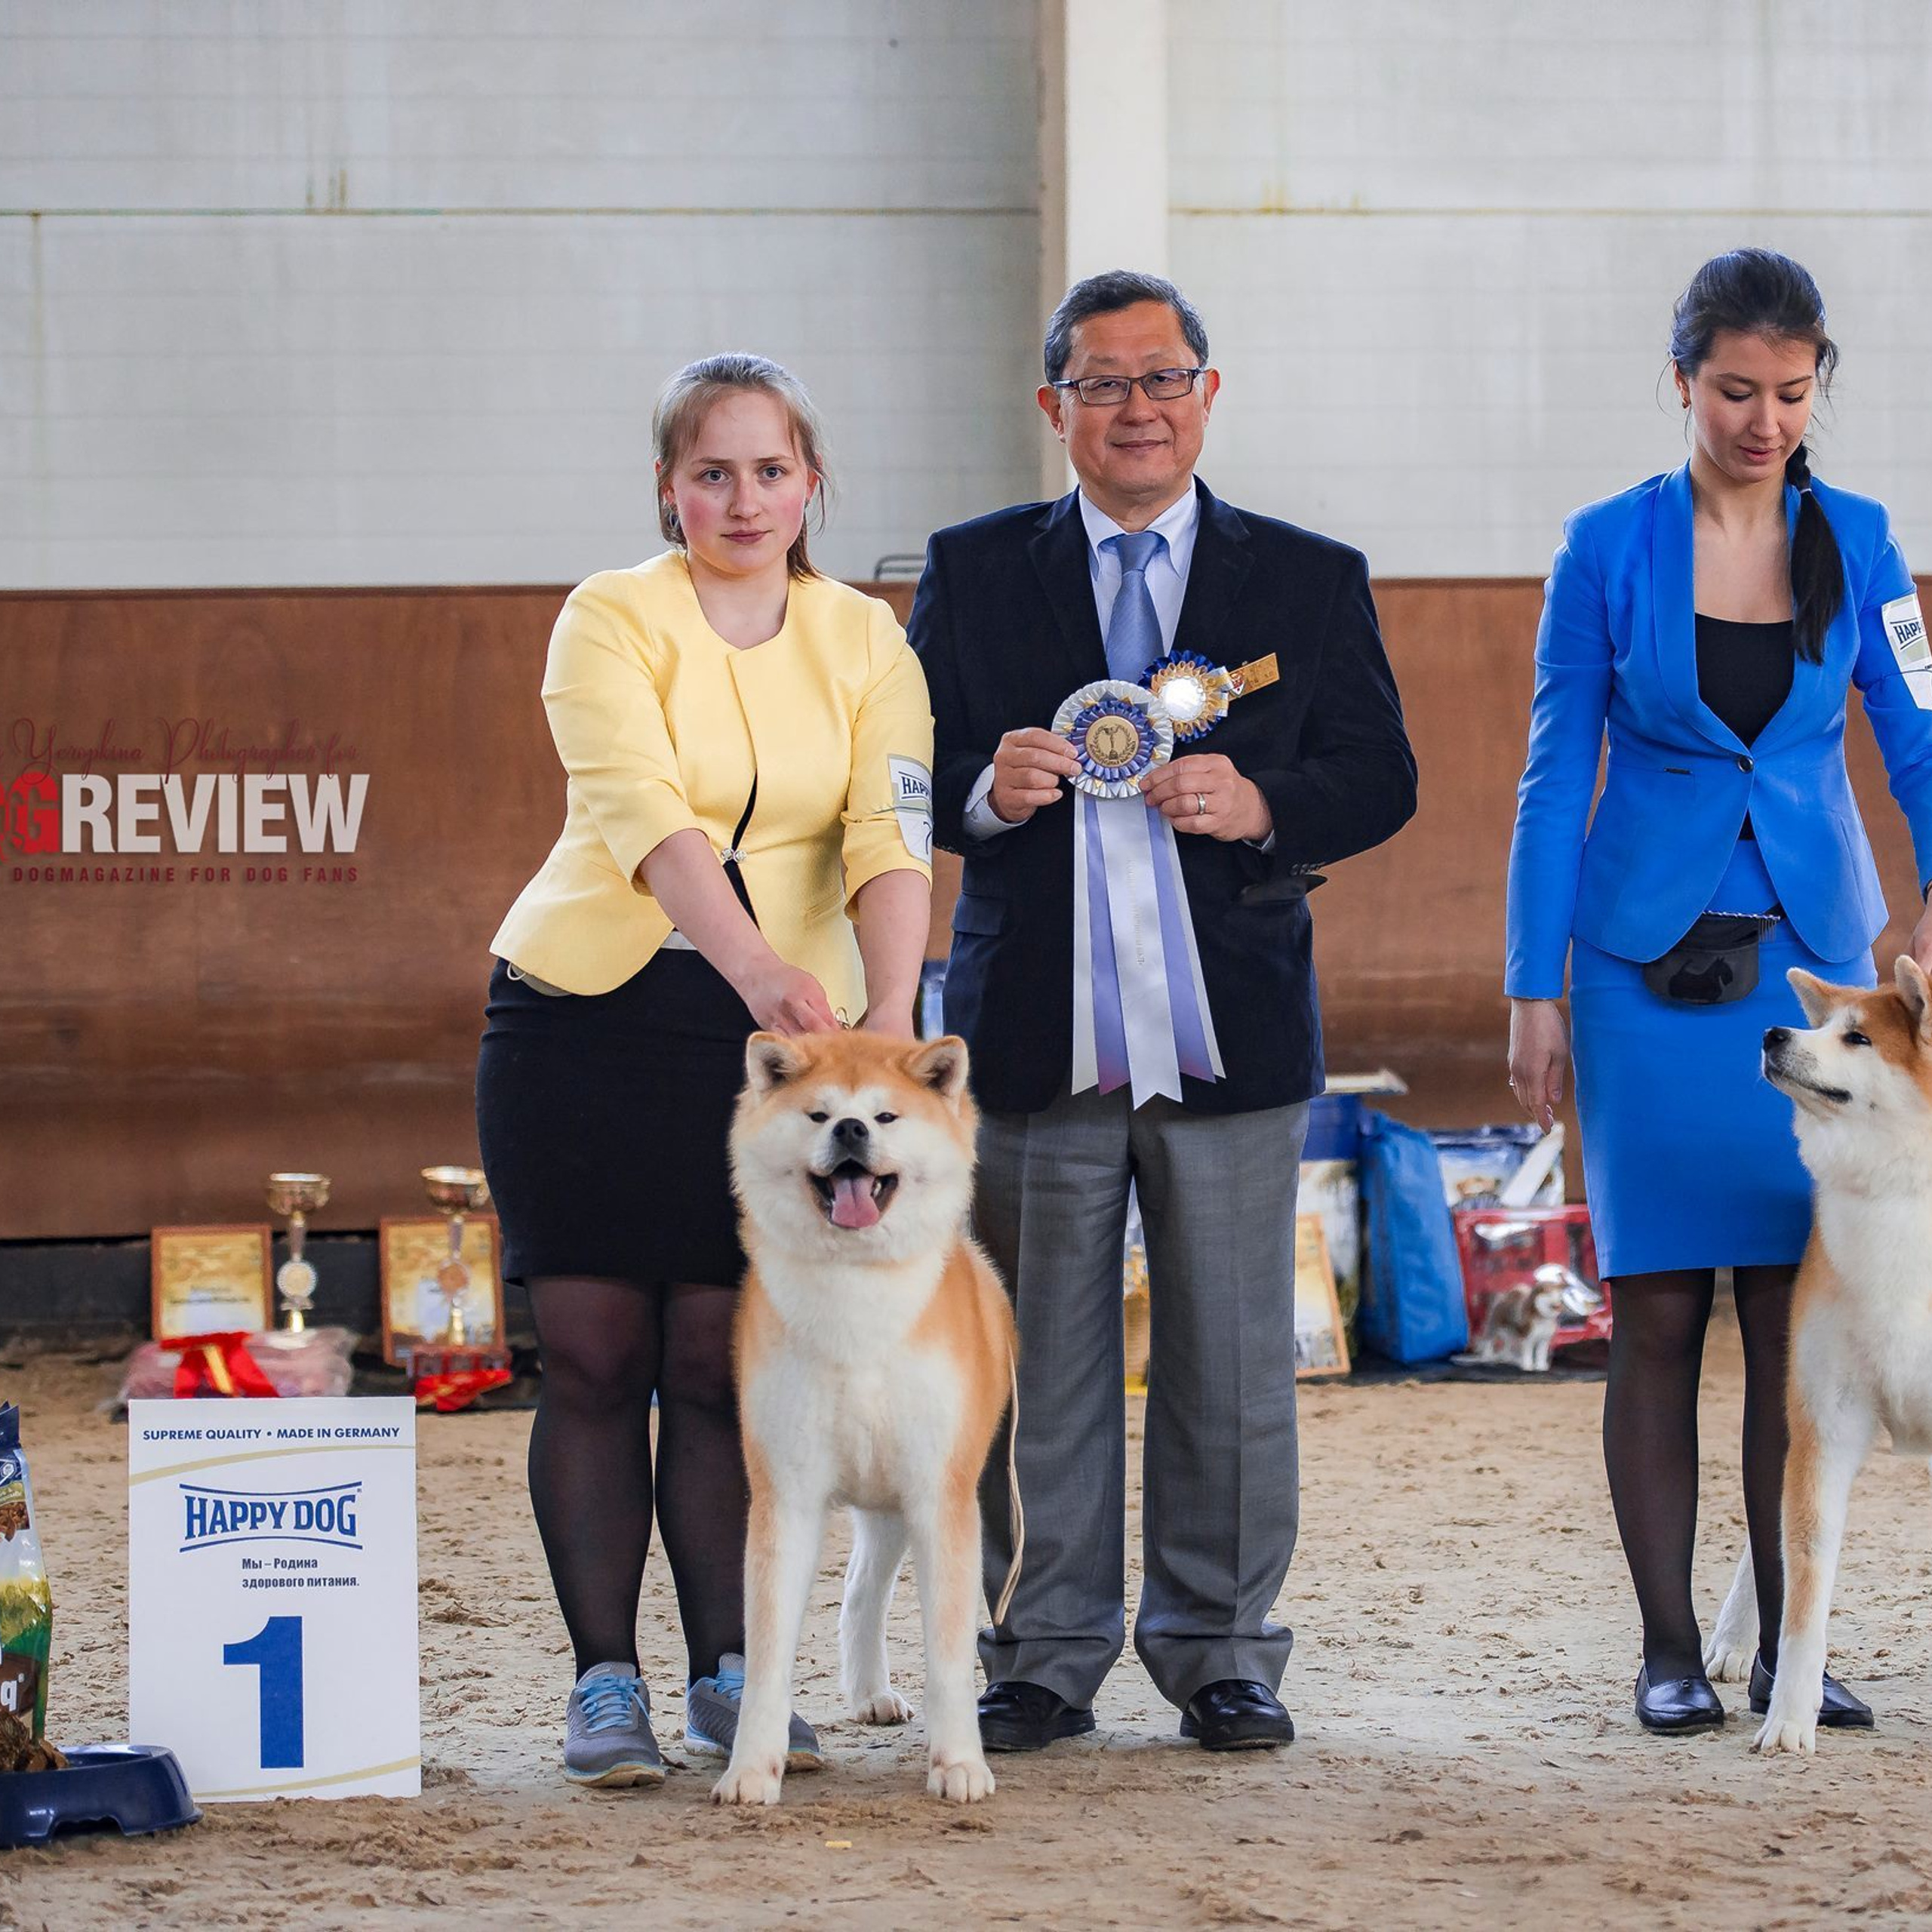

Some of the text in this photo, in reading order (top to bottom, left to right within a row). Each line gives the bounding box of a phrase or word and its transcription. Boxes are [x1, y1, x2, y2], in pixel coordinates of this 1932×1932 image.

[143, 1427, 400, 1440] SUPREME QUALITY MADE IN GERMANY
[185, 1494, 356, 1540] HAPPY DOG
[242, 1558, 318, 1570] Мы Родина
[242, 1577, 360, 1589] здорового питания.
[224, 1616, 304, 1768] 1
